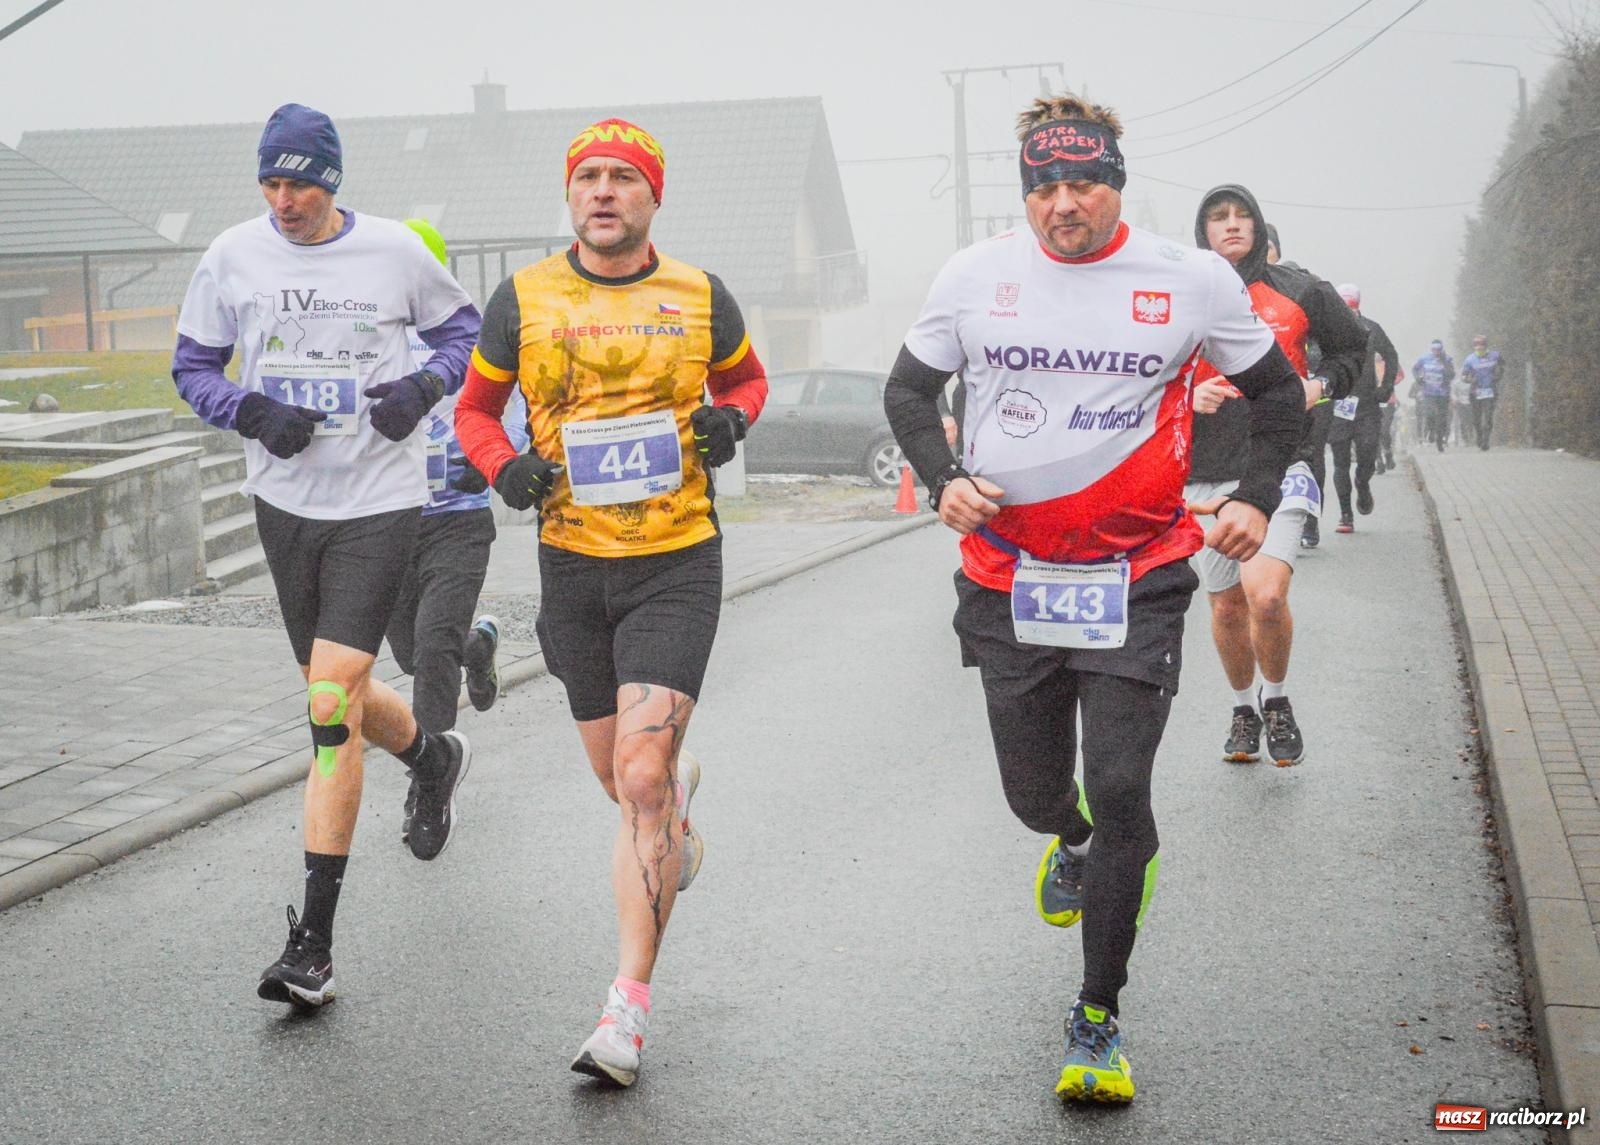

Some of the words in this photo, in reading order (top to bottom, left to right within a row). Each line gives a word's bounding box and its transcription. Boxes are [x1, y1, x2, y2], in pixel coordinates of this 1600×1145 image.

[1033, 126, 1077, 141] ULTRA
[1036, 135, 1098, 151] ZADEK
[280, 288, 318, 312] IV
[313, 299, 378, 312] Eko-Cross
[298, 313, 309, 321] po
[309, 312, 331, 320] Ziemi
[989, 310, 1018, 319] Prudnik
[353, 321, 377, 333] 10km
[551, 324, 626, 339] ENERGY
[632, 324, 685, 337] TEAM
[983, 345, 1164, 378] MORAWIEC
[279, 379, 340, 412] 118
[598, 440, 651, 480] 44
[1029, 584, 1105, 622] 143
